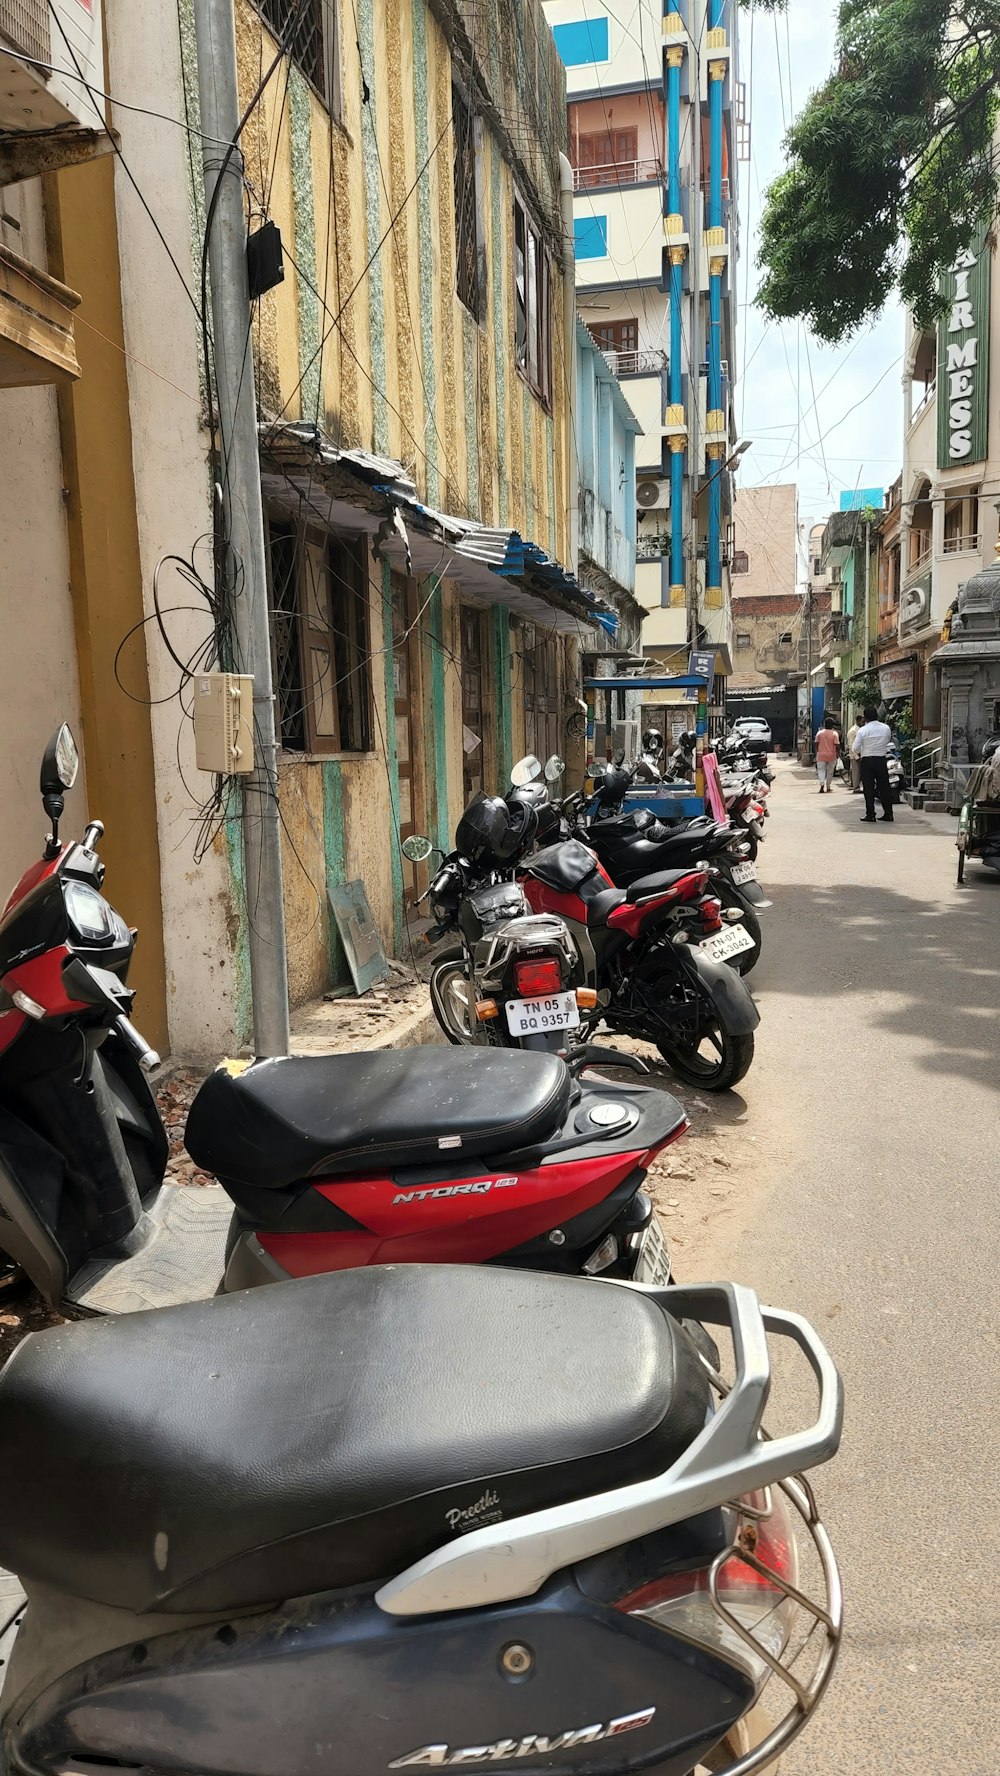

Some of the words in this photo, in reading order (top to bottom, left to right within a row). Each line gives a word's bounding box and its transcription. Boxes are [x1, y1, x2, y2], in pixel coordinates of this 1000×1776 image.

[946, 338, 979, 459] MESS
[712, 938, 750, 959] CK-3042
[523, 1002, 541, 1014] TN
[544, 1000, 559, 1011] 05
[519, 1018, 538, 1030] BQ
[541, 1013, 570, 1027] 9357
[392, 1181, 492, 1205] NTORQ
[495, 1178, 518, 1188] 125
[445, 1489, 500, 1530] Preethi
[388, 1723, 607, 1769] Activa
